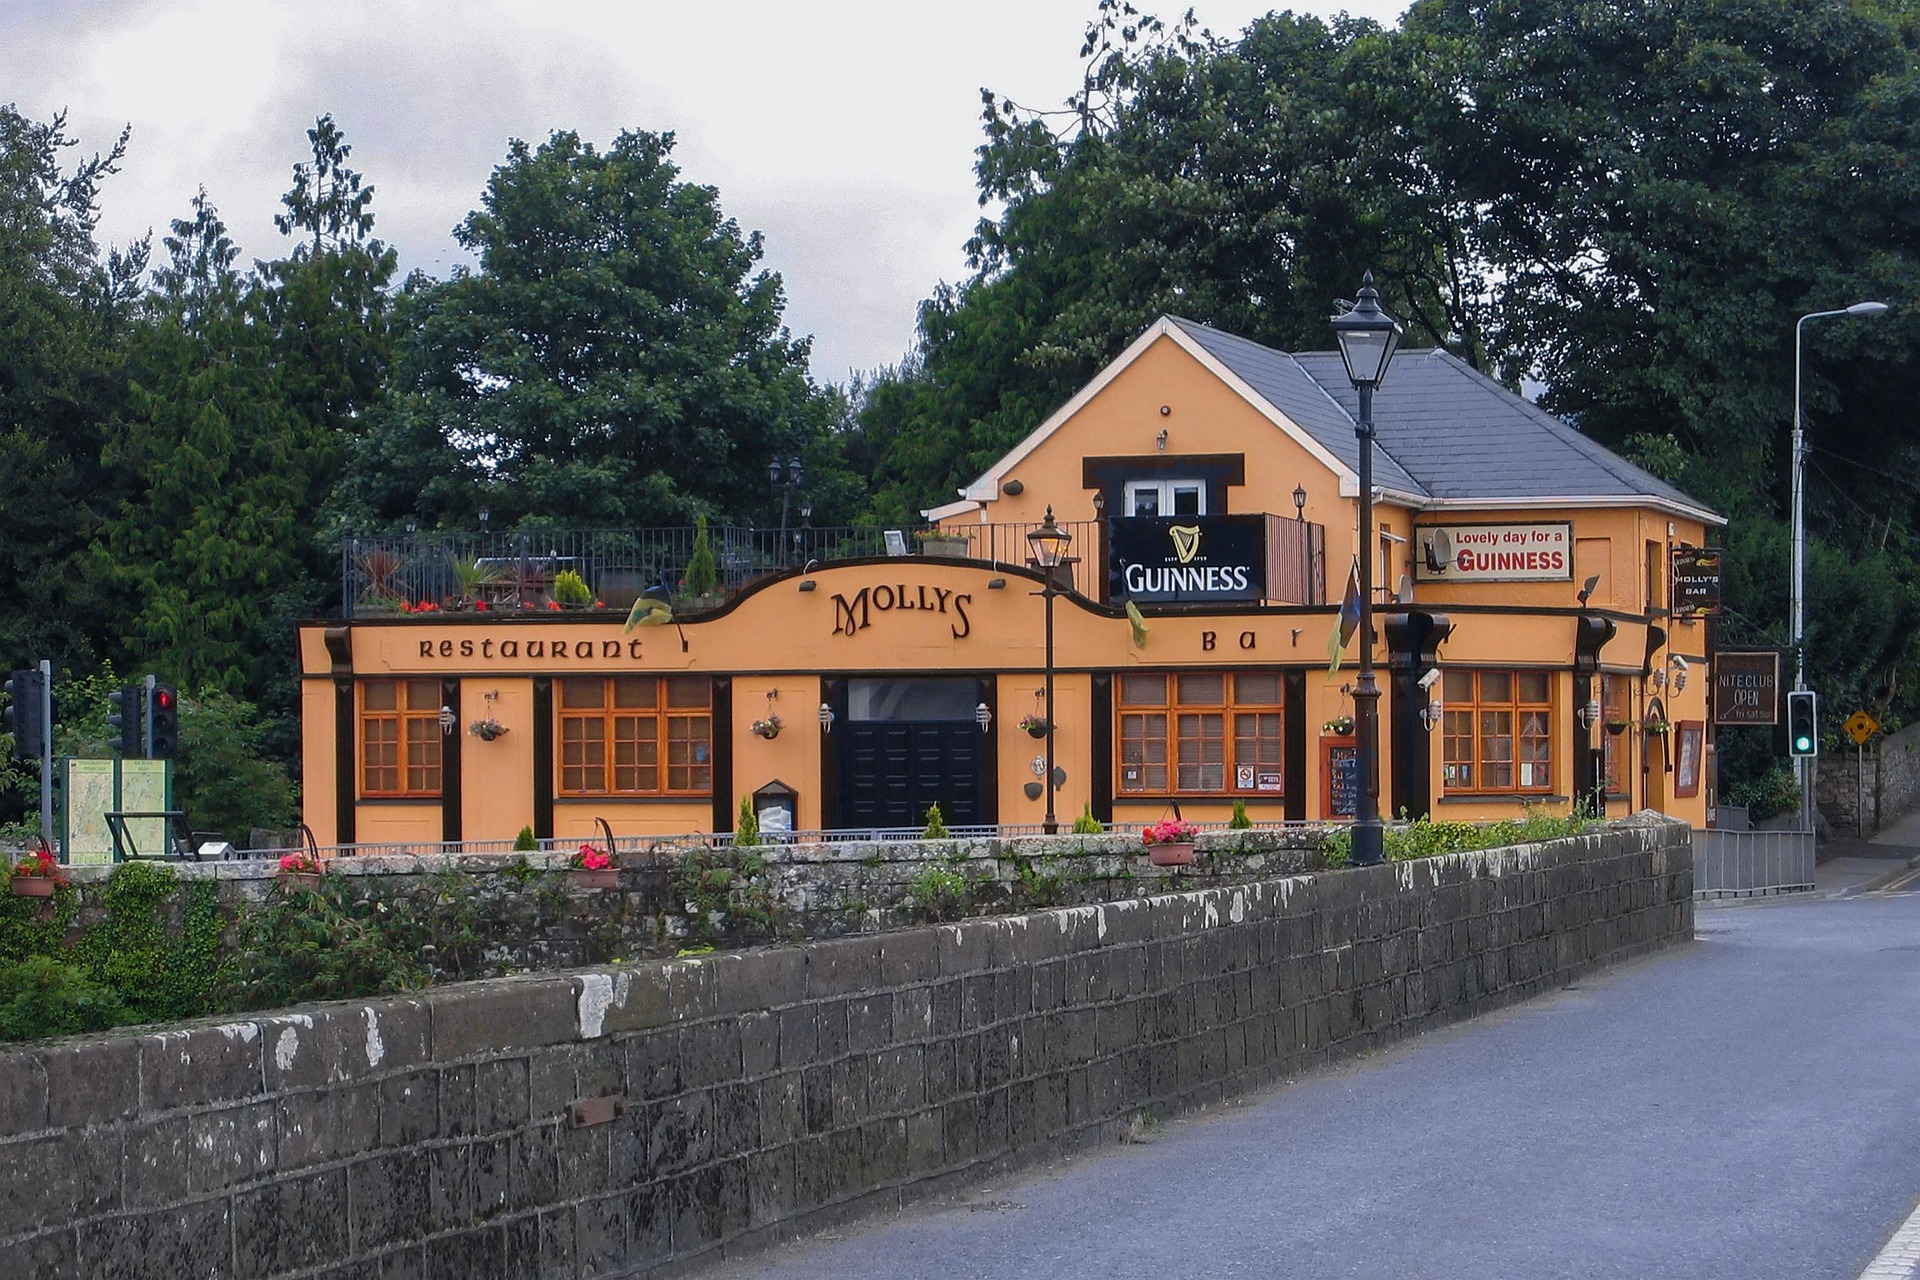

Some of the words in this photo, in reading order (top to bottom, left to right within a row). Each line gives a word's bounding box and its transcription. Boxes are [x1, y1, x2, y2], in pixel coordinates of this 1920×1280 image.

[1456, 532, 1499, 546] Lovely
[1503, 531, 1527, 545] day
[1531, 530, 1550, 542] for
[1554, 532, 1562, 542] a
[1457, 549, 1564, 572] GUINNESS
[1125, 564, 1249, 592] GUINNESS
[1734, 689, 1759, 706] OPEN
